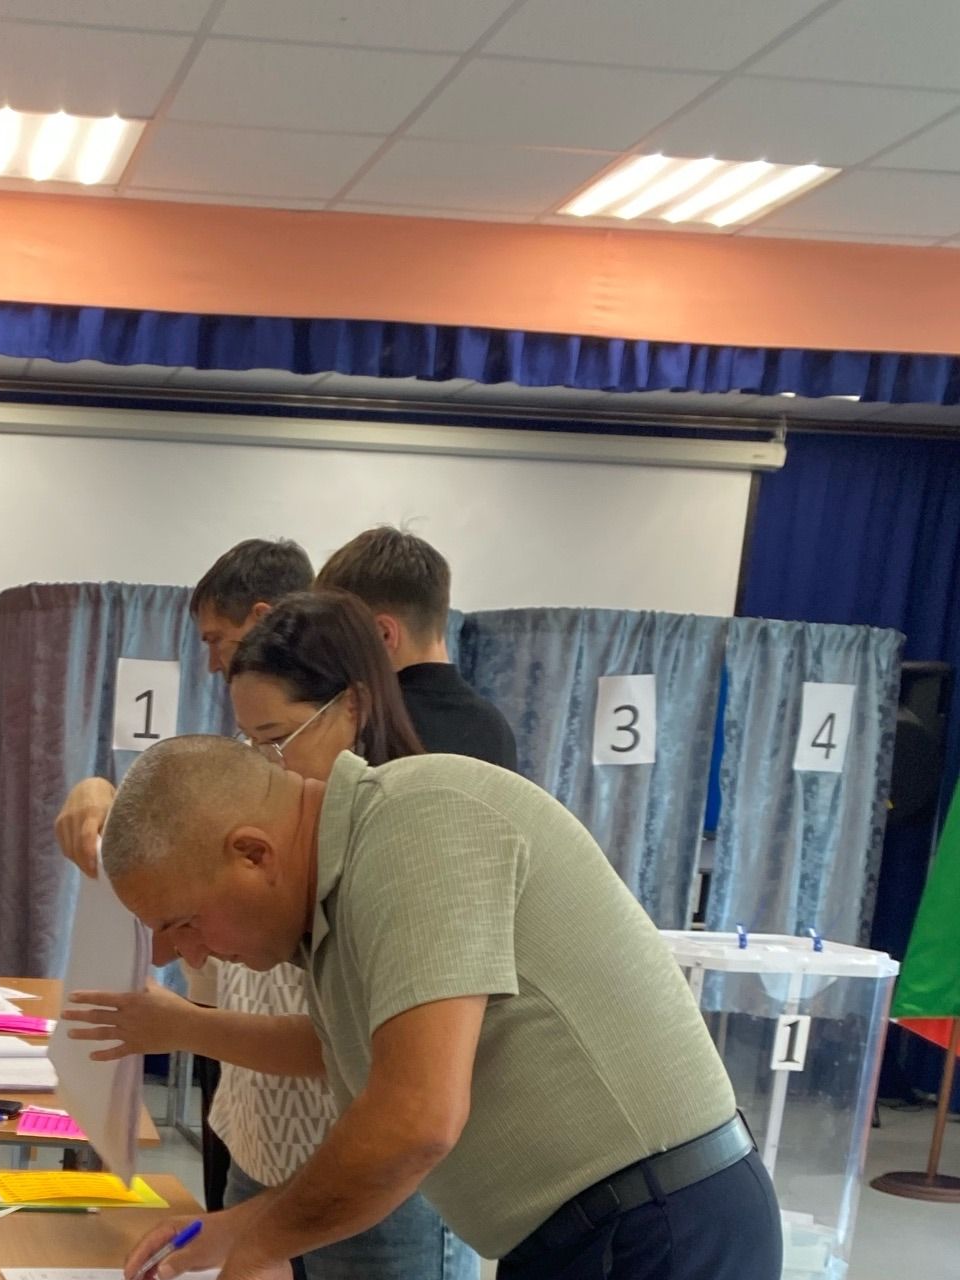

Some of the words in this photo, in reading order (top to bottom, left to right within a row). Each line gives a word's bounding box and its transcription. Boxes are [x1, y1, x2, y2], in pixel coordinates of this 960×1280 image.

[133, 690, 159, 739] 1
[612, 704, 640, 752] 3
[812, 713, 835, 758] 4
[782, 1018, 800, 1062] 1
